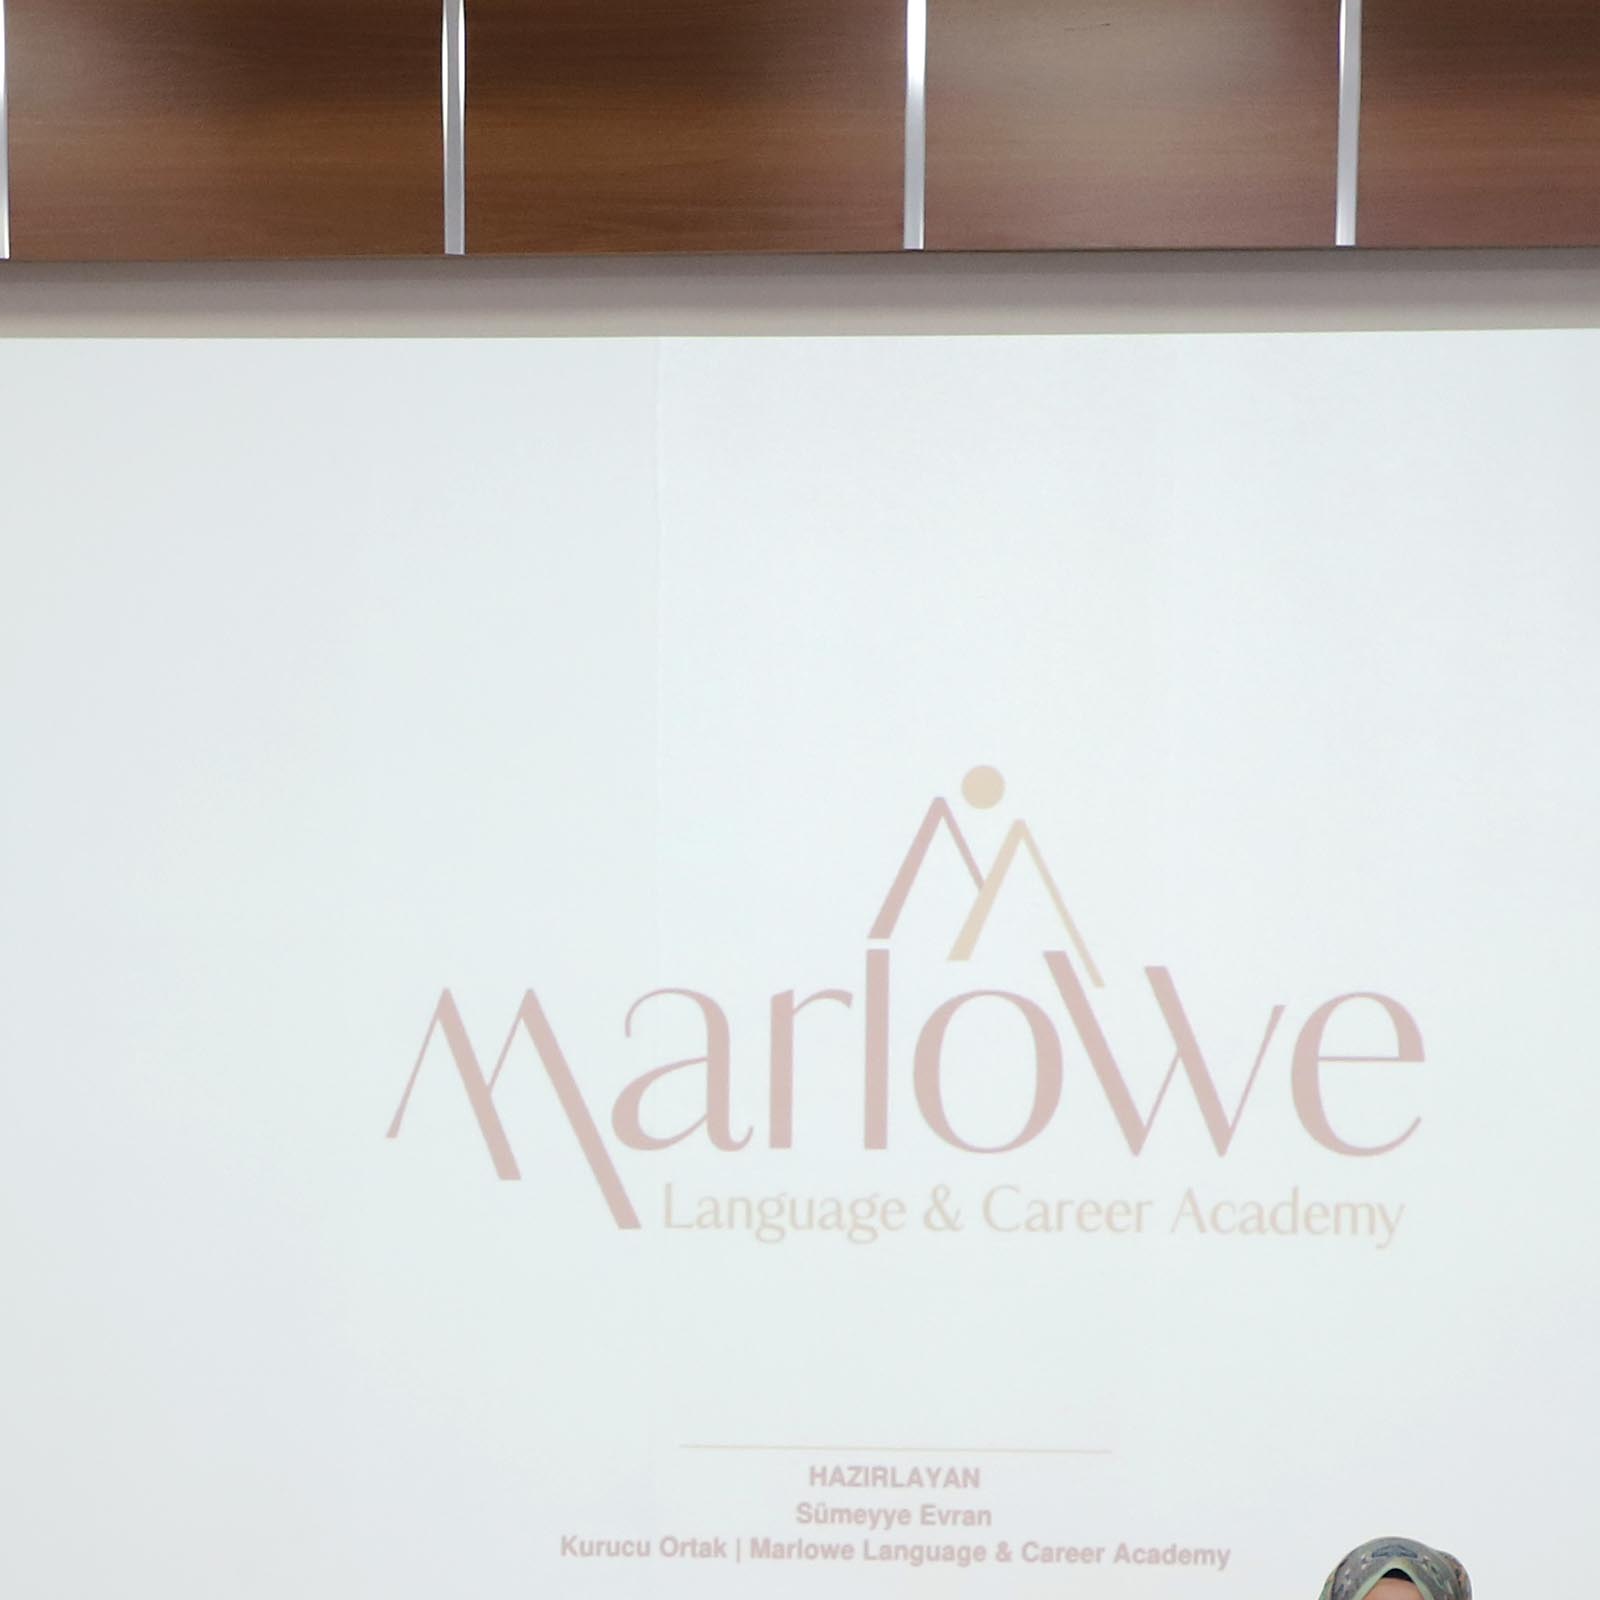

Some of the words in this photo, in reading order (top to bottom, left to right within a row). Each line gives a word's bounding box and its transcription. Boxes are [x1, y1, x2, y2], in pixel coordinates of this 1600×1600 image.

[385, 947, 1426, 1230] Marlowe
[664, 1182, 908, 1247] Language
[923, 1184, 965, 1234] &
[982, 1184, 1155, 1236] Career
[1171, 1185, 1407, 1252] Academy
[809, 1465, 982, 1491] HAZIRLAYAN
[796, 1502, 913, 1532] Sümeyye
[920, 1503, 994, 1529] Evran
[560, 1535, 652, 1560] Kurucu
[659, 1535, 728, 1560] Ortak
[749, 1537, 857, 1564] Marlowe
[863, 1538, 988, 1570] Language
[995, 1541, 1015, 1565] &
[1021, 1541, 1107, 1566] Career
[1113, 1542, 1233, 1574] Academy
